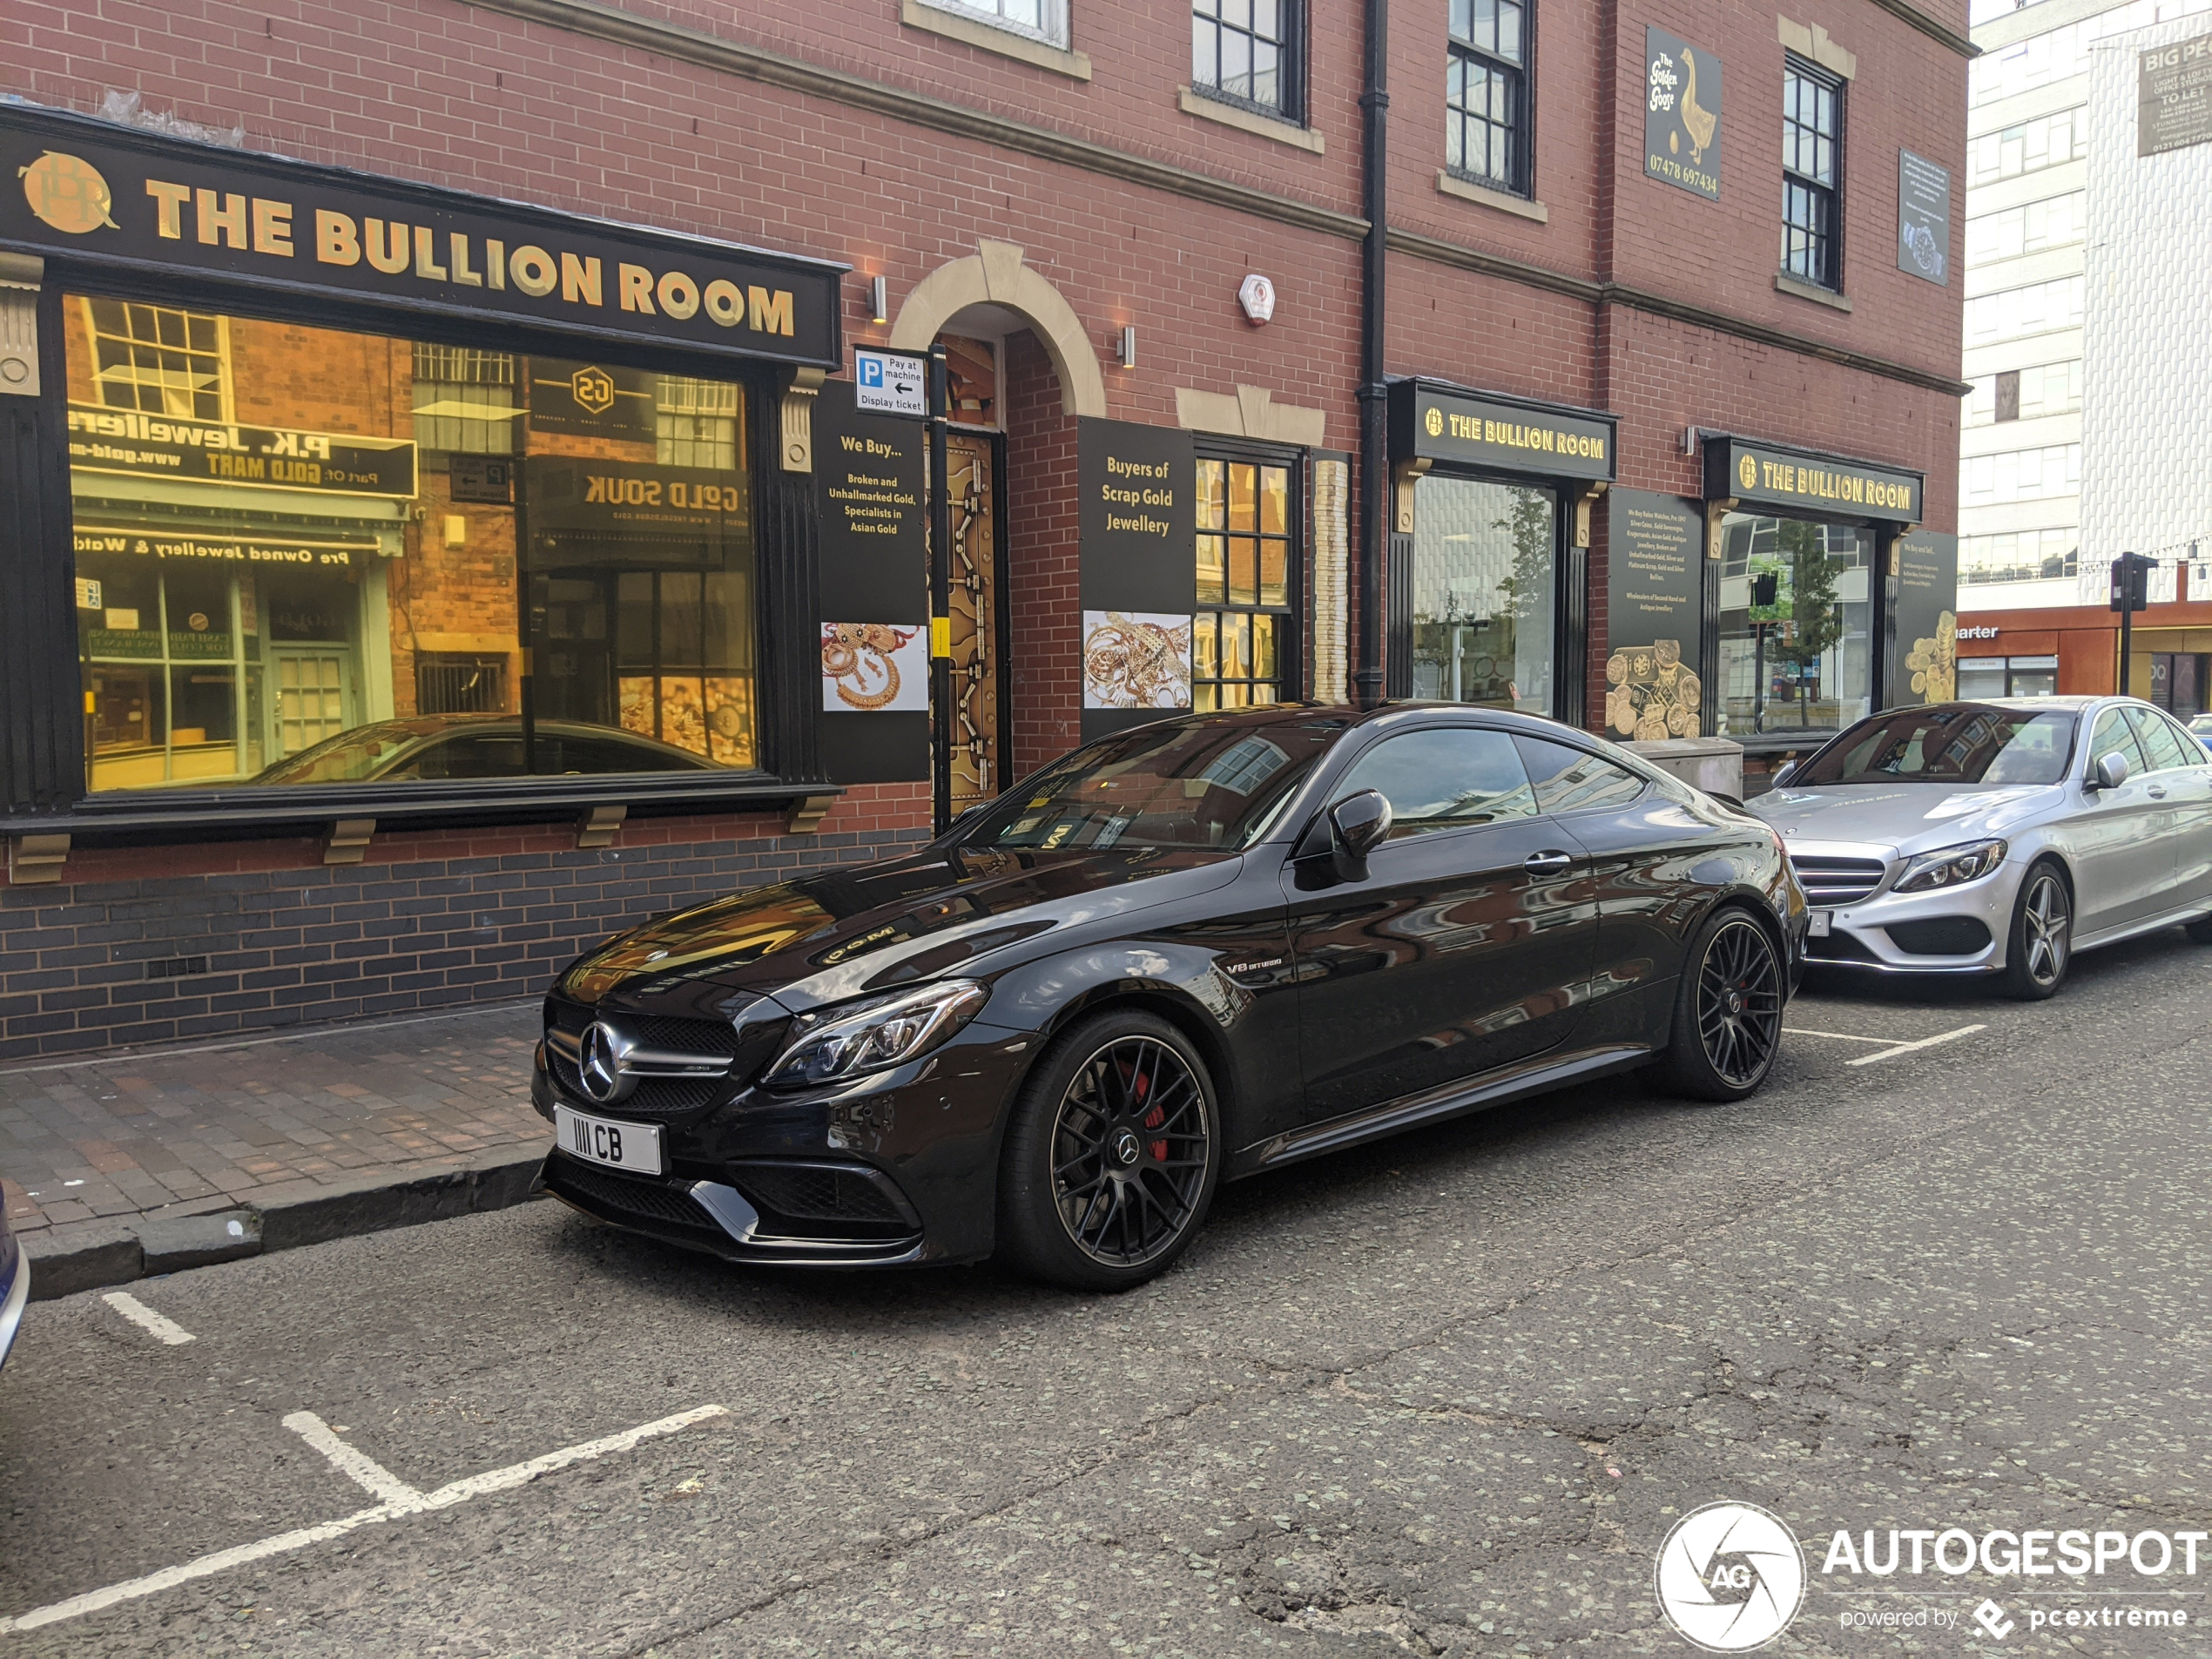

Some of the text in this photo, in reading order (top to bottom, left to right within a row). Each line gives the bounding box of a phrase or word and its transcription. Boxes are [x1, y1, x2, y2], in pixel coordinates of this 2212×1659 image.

[1660, 52, 1673, 68] The
[2146, 49, 2178, 71] BIG
[1650, 61, 1677, 91] Golden
[2155, 76, 2177, 87] LIGHT
[1649, 86, 1674, 111] Goose
[2155, 84, 2179, 94] OFFICE
[2161, 85, 2206, 105] TO LET
[2152, 117, 2189, 129] STUNNING
[2153, 141, 2173, 152] 0121
[2175, 138, 2189, 147] 604
[1650, 154, 1716, 192] 07478 697434
[146, 179, 794, 336] THE BULLION ROOM
[865, 361, 921, 384] P machine
[890, 358, 916, 370] Pay at
[861, 395, 921, 410] Display ticket
[840, 435, 902, 458] We Buy...
[1449, 414, 1604, 459] THE BULLION ROOM
[1108, 456, 1169, 478] Buyers of
[847, 474, 898, 487] Broken and
[1763, 461, 1911, 509] THE BULLION ROOM
[829, 488, 916, 505] Unhallmarked Gold,
[1103, 484, 1172, 507] Scrap Gold
[845, 505, 901, 519] Specialists in
[851, 523, 897, 534] Asian Gold
[1107, 513, 1169, 536] Jewellery
[1226, 959, 1282, 974] V8 BITURBO
[595, 1124, 623, 1163] CB
